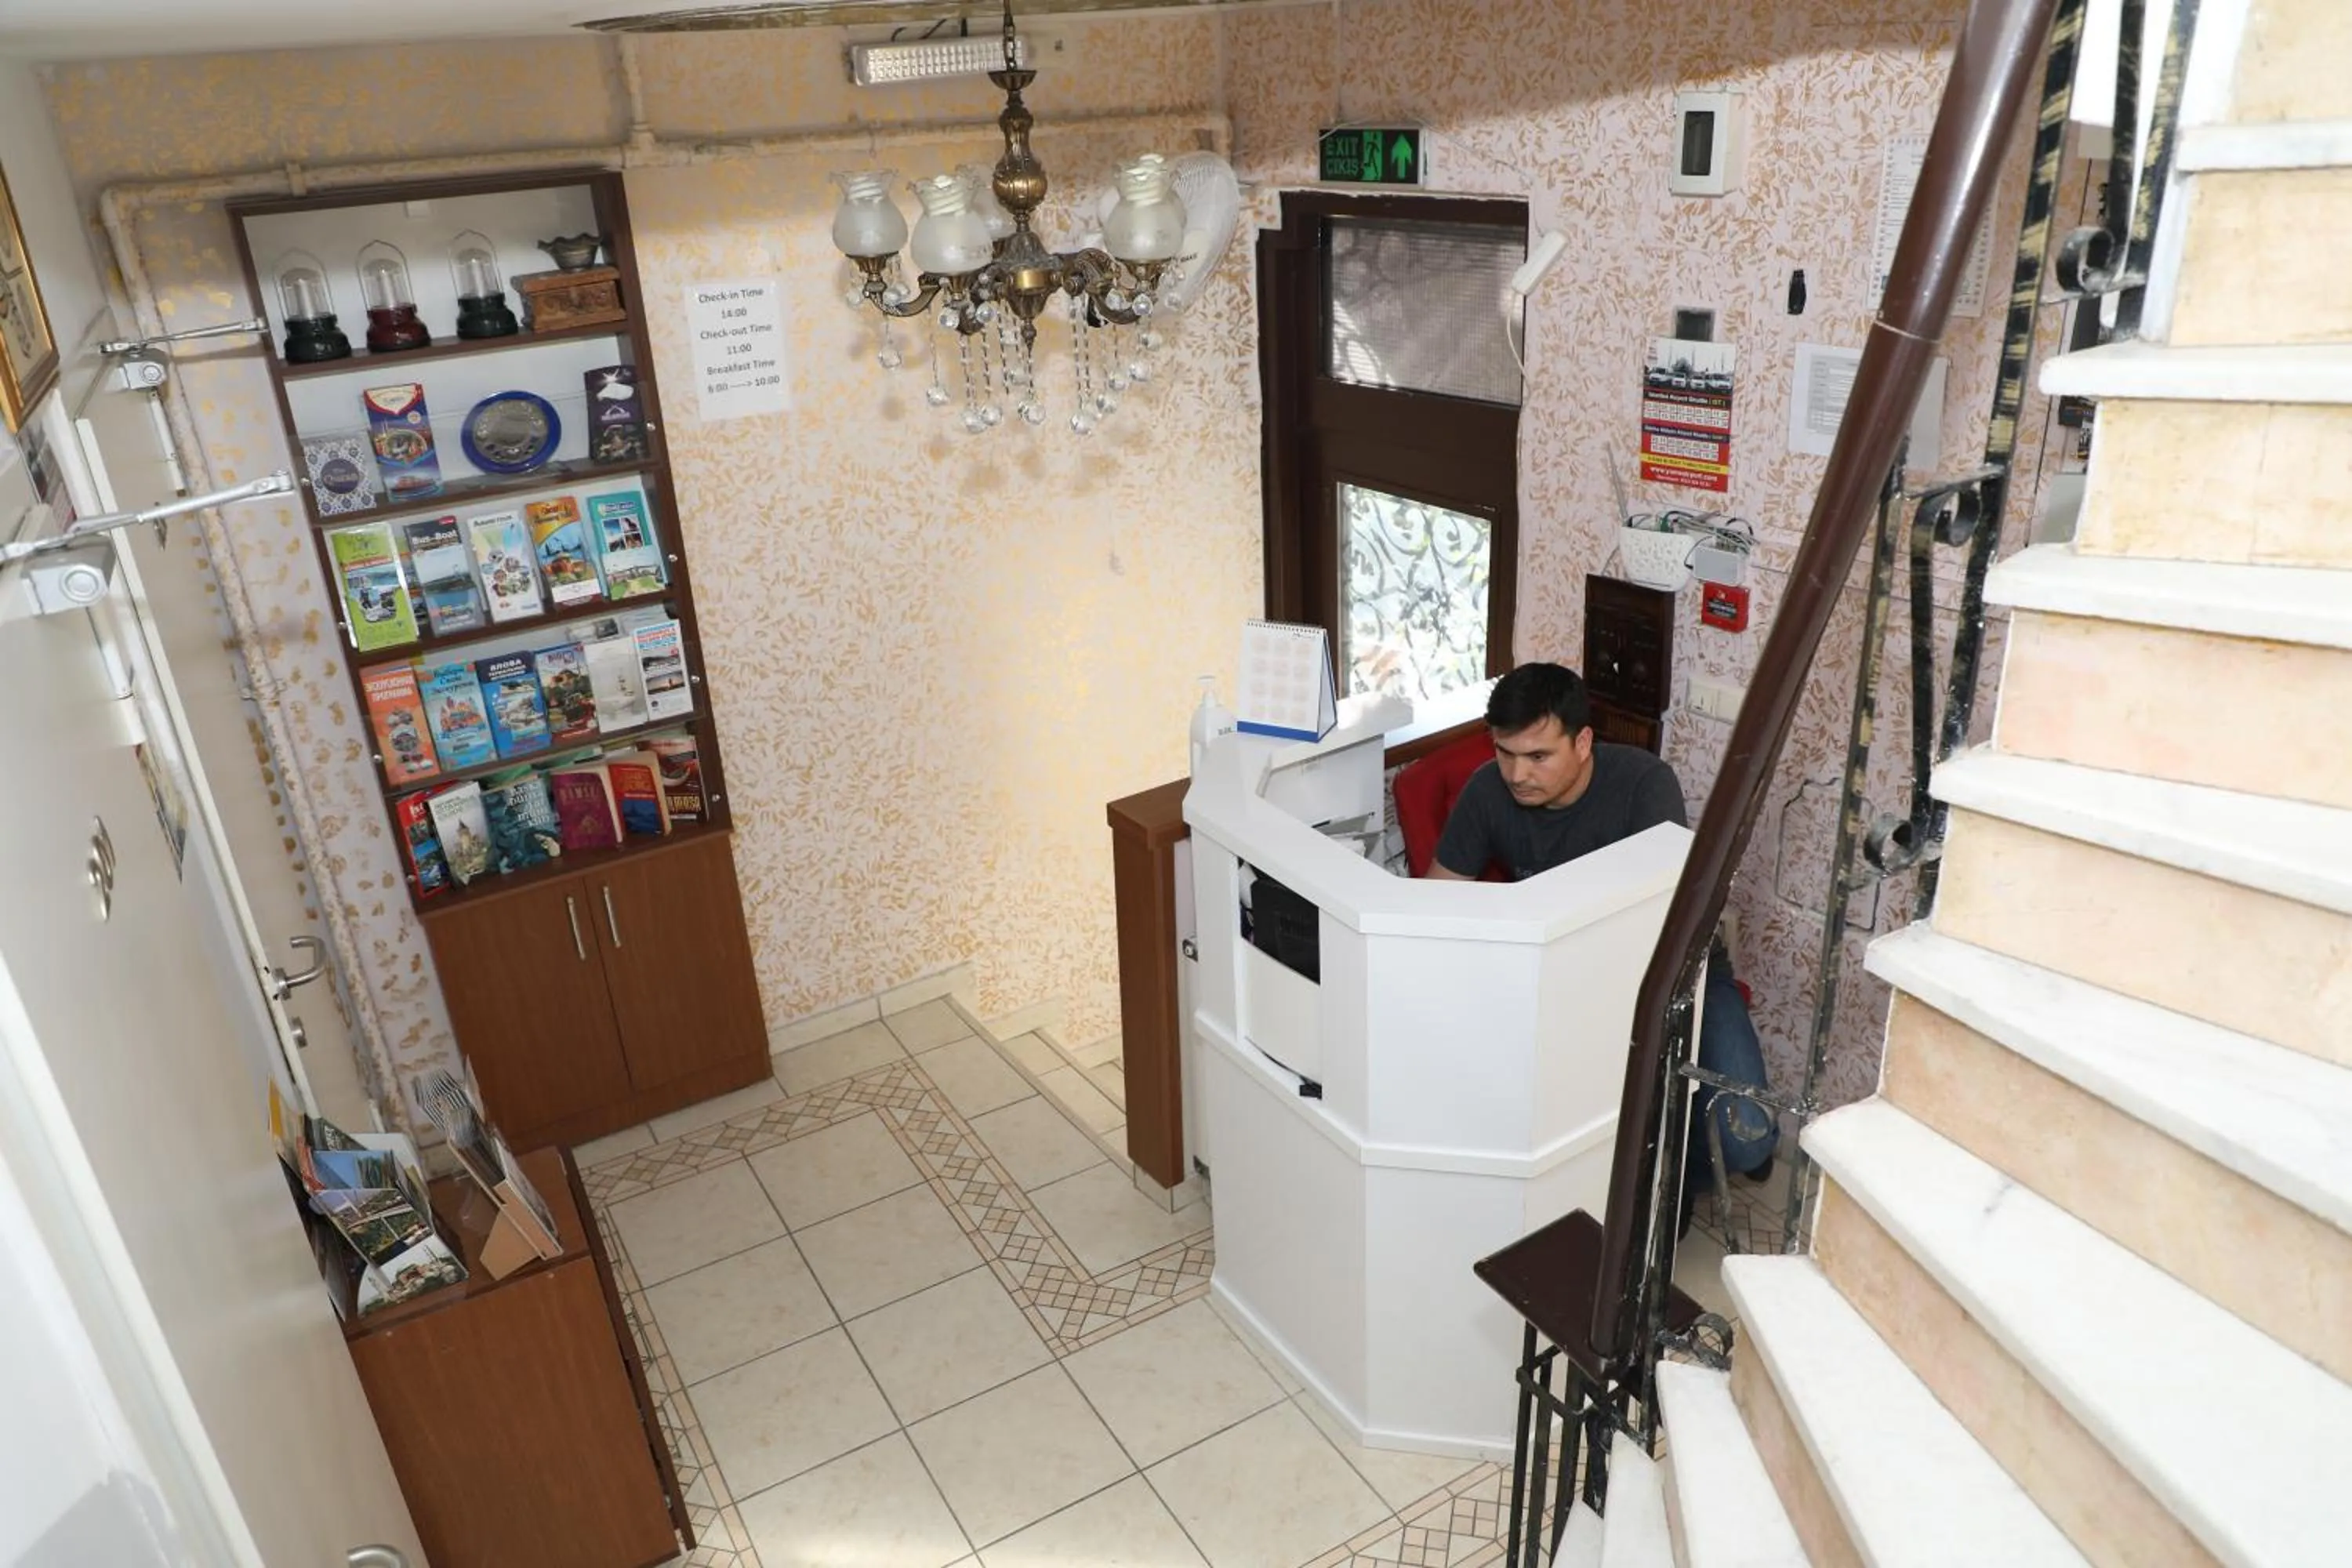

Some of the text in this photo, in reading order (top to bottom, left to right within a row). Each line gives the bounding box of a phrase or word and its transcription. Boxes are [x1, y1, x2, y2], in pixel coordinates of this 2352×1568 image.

[1326, 136, 1359, 156] EXIT
[698, 288, 764, 303] Check-in Time
[700, 324, 772, 339] Check-out Time
[706, 359, 775, 375] Breakfast Time
